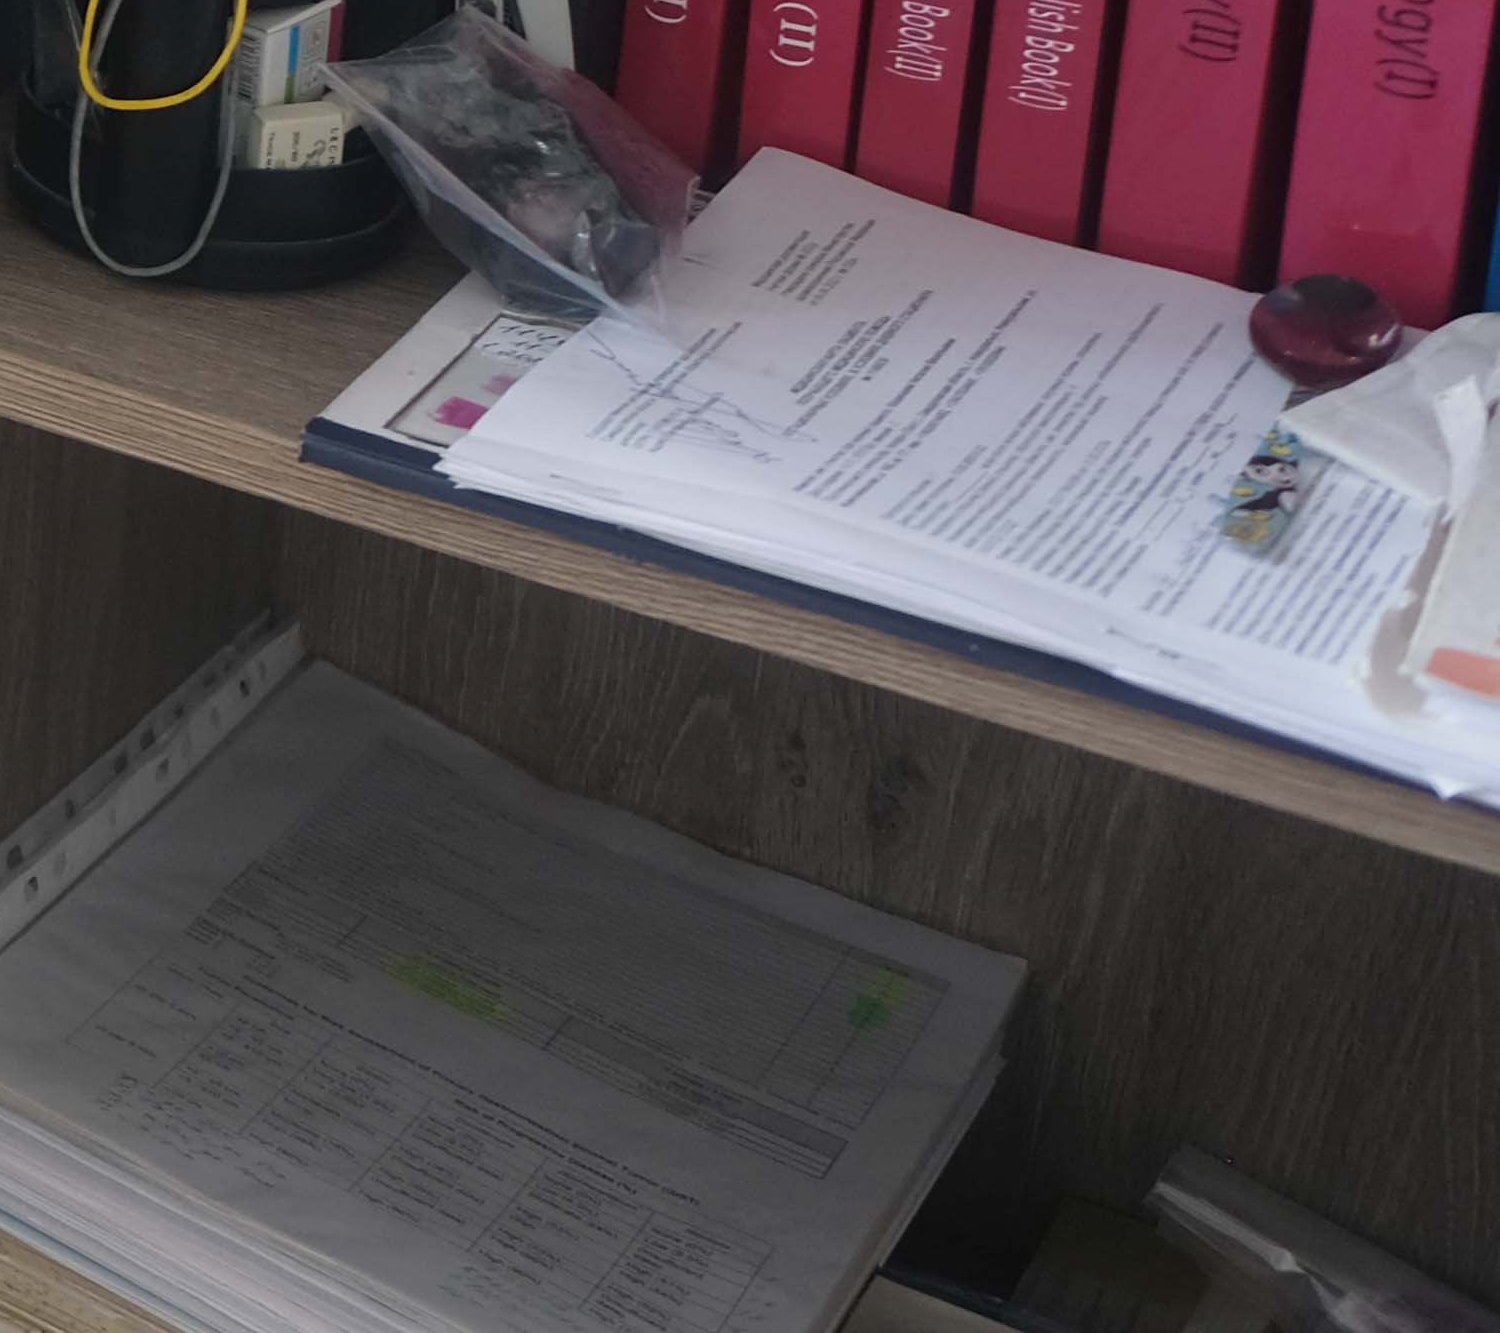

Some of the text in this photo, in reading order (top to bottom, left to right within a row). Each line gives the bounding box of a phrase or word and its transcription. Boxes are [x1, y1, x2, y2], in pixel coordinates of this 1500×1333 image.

[770, 1, 819, 67] (II)
[883, 0, 950, 82] Book(II)
[1008, 35, 1075, 112] Book(I)
